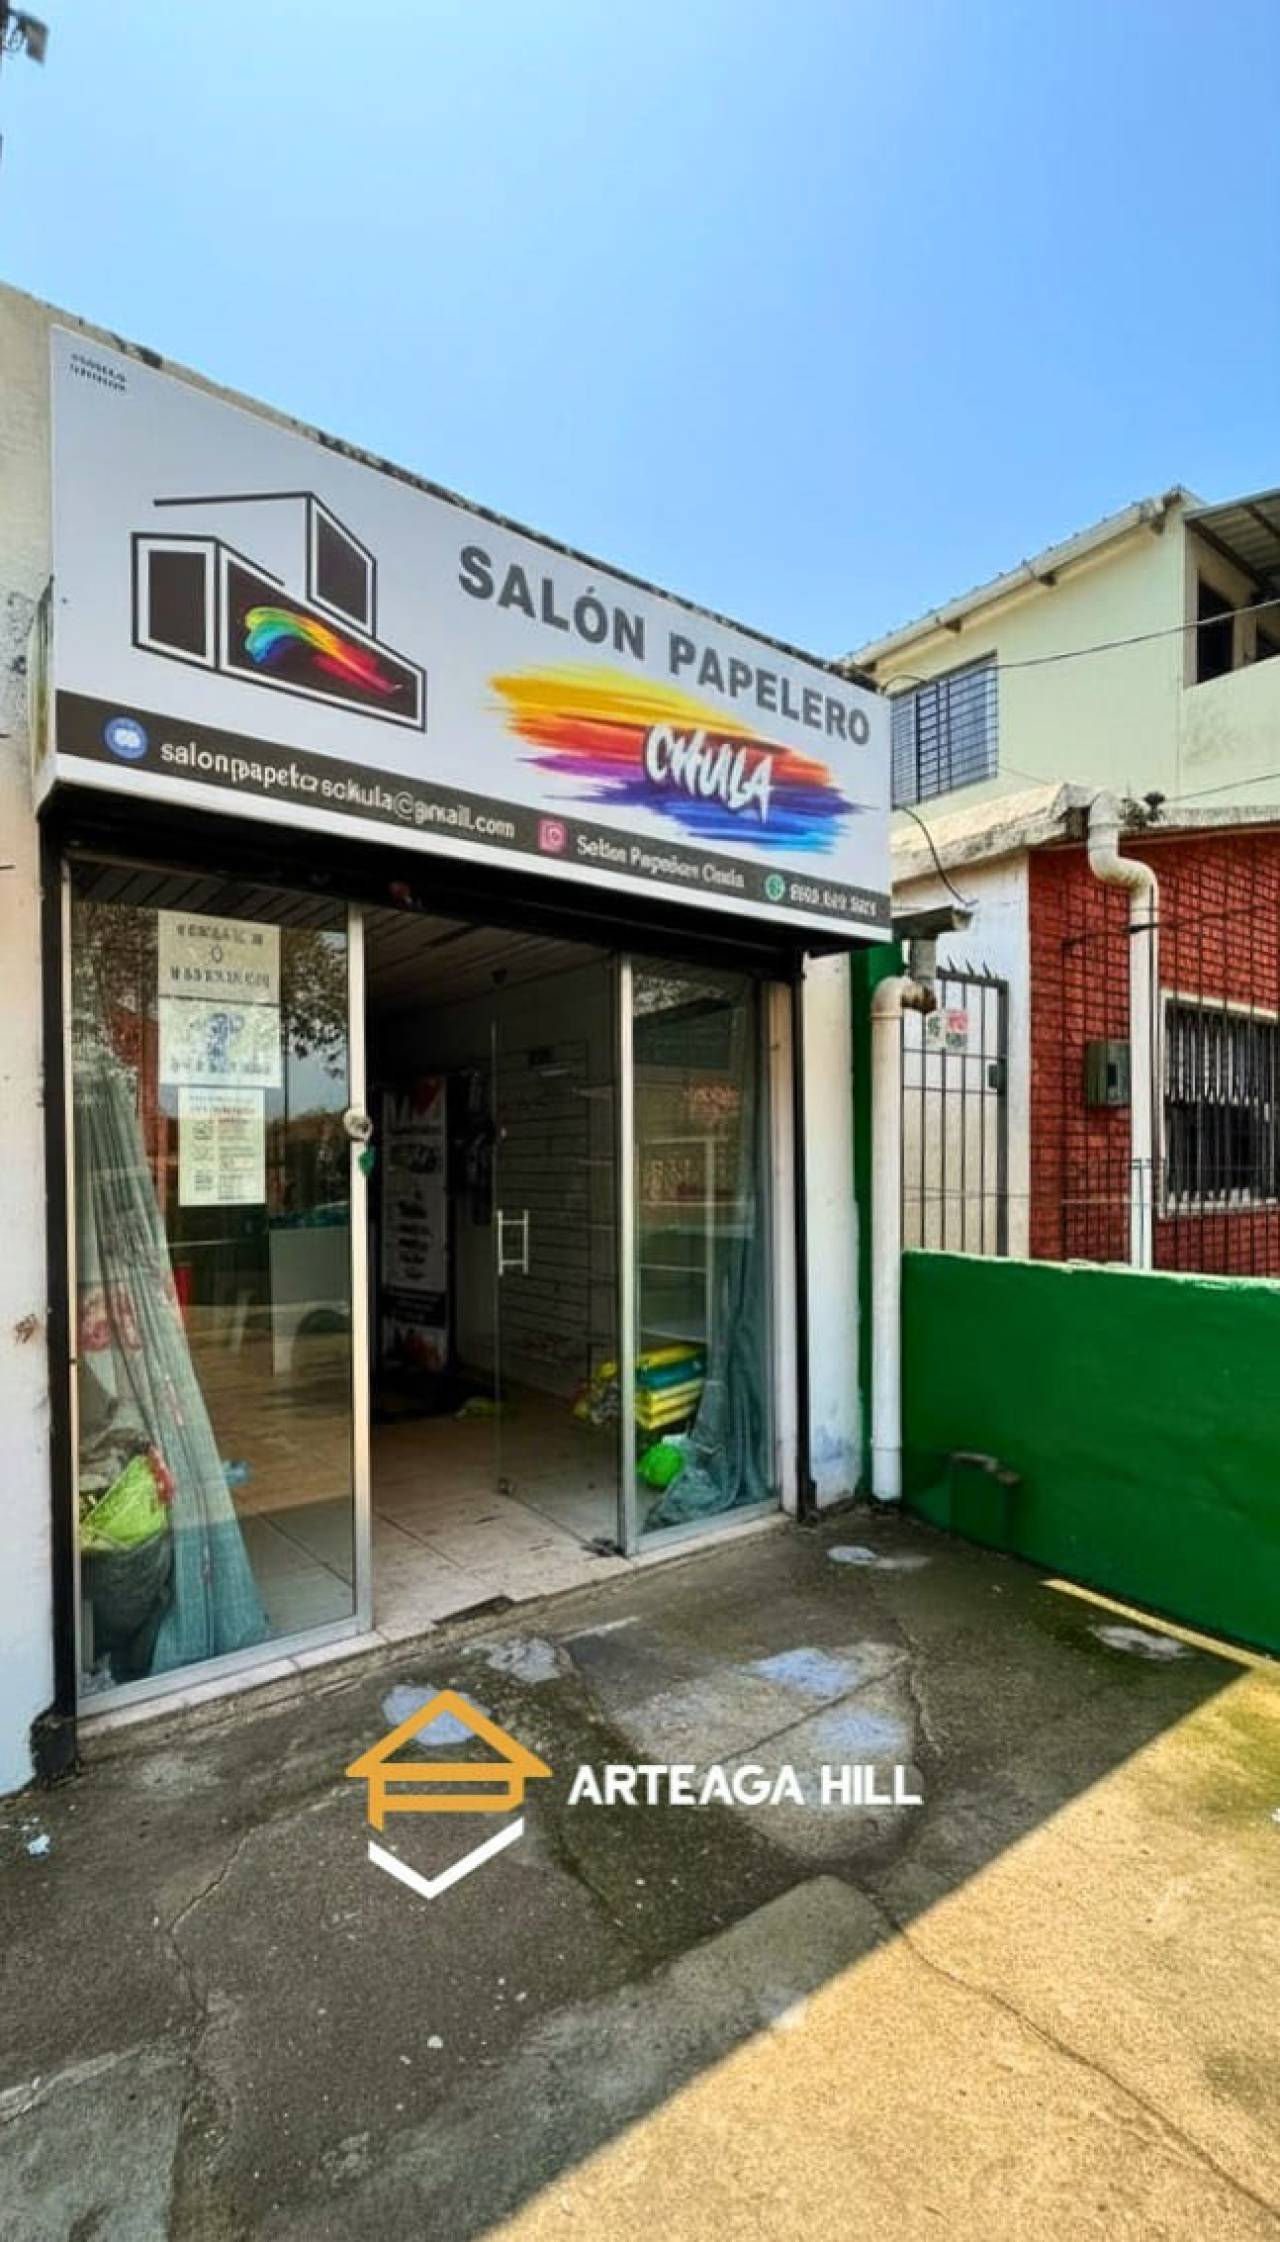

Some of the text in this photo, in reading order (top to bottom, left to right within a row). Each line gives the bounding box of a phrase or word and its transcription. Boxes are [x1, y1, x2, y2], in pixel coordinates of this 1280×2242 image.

[458, 545, 870, 745] SALÓN PAPELERO
[646, 723, 773, 823] CHULA
